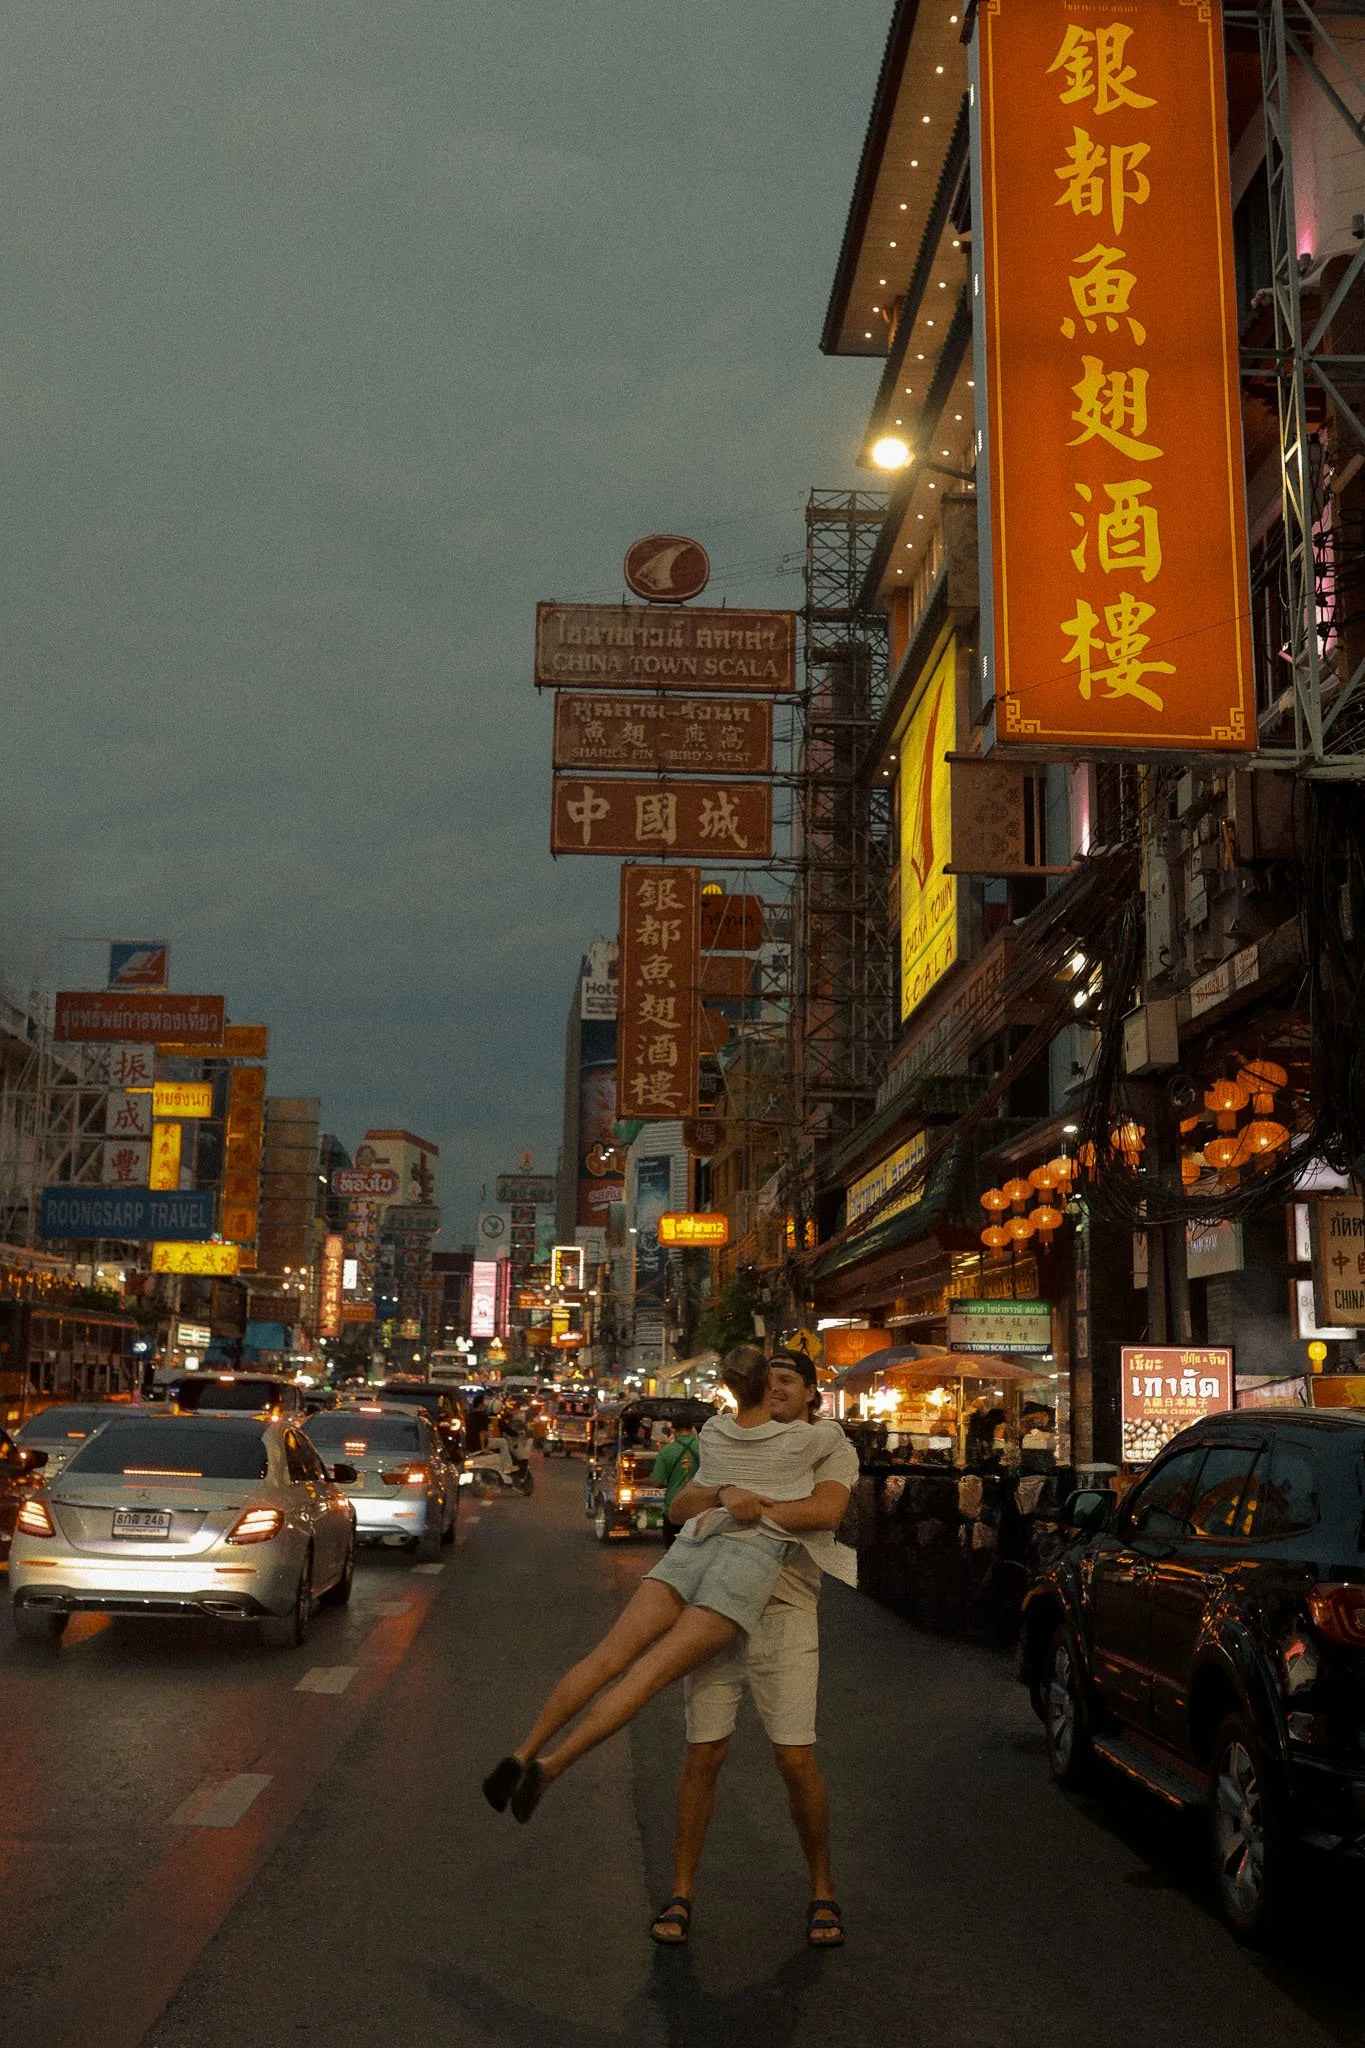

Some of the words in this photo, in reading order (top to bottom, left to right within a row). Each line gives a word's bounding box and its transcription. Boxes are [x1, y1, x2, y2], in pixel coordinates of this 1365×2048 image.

[1045, 22, 1177, 713] 銀都魚翅酒樓
[553, 653, 622, 672] CHINA
[631, 655, 697, 675] TOWN
[704, 658, 778, 677] SCALA
[632, 749, 653, 760] FIN
[670, 750, 713, 762] BIRD'S
[718, 752, 751, 762] NEST
[566, 785, 748, 849] 中國城
[905, 914, 928, 963] CHINA
[931, 878, 953, 927] TOWN
[630, 878, 687, 1109] 銀都魚翅酒樓
[904, 935, 953, 1014] SCALA
[111, 1050, 150, 1182] 振成豐
[47, 1199, 144, 1228] ROONGSARP
[150, 1202, 208, 1229] TRAVEL
[1131, 1368, 1220, 1398] เกาลัด
